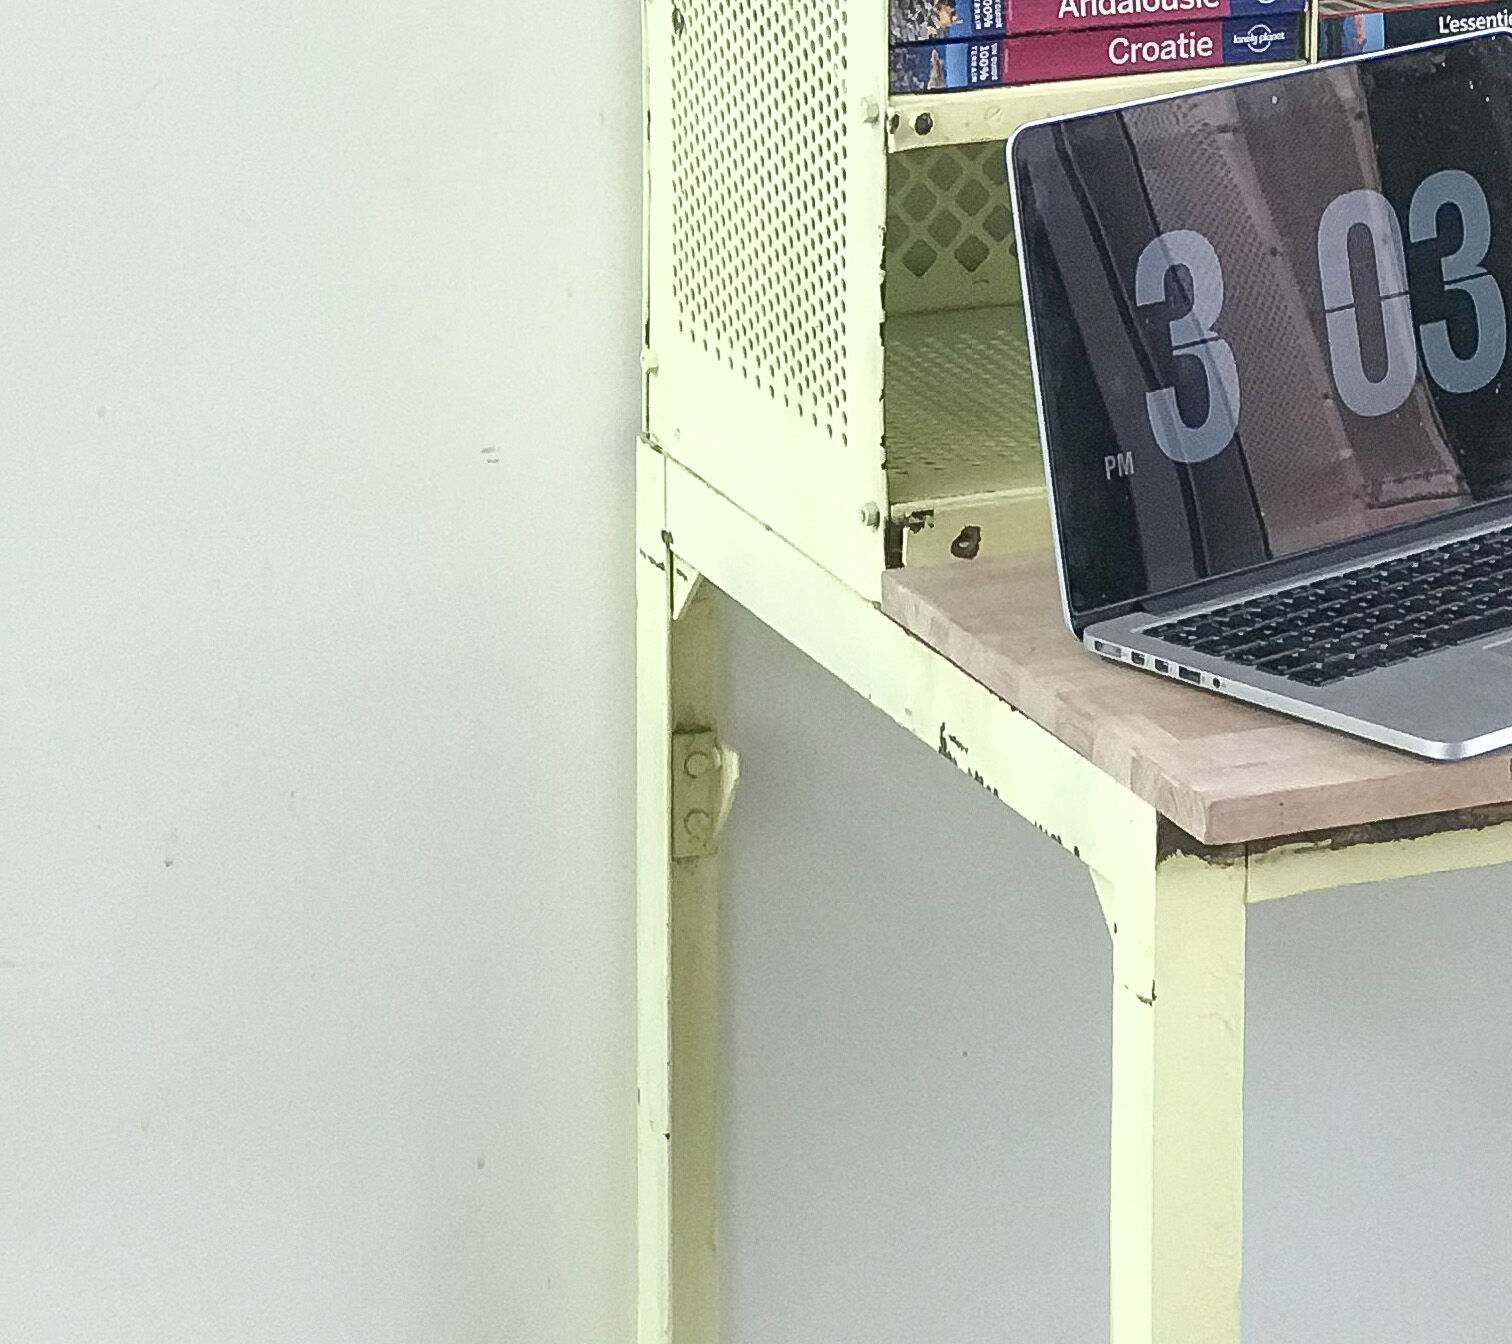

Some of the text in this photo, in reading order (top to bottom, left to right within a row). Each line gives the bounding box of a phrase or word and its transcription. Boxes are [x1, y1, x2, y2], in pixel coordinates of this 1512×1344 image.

[1108, 32, 1213, 65] Croatie
[1233, 31, 1286, 46] lonely planet
[979, 45, 989, 81] 100%
[1134, 169, 1508, 465] 3 03
[1104, 451, 1135, 481] PM
